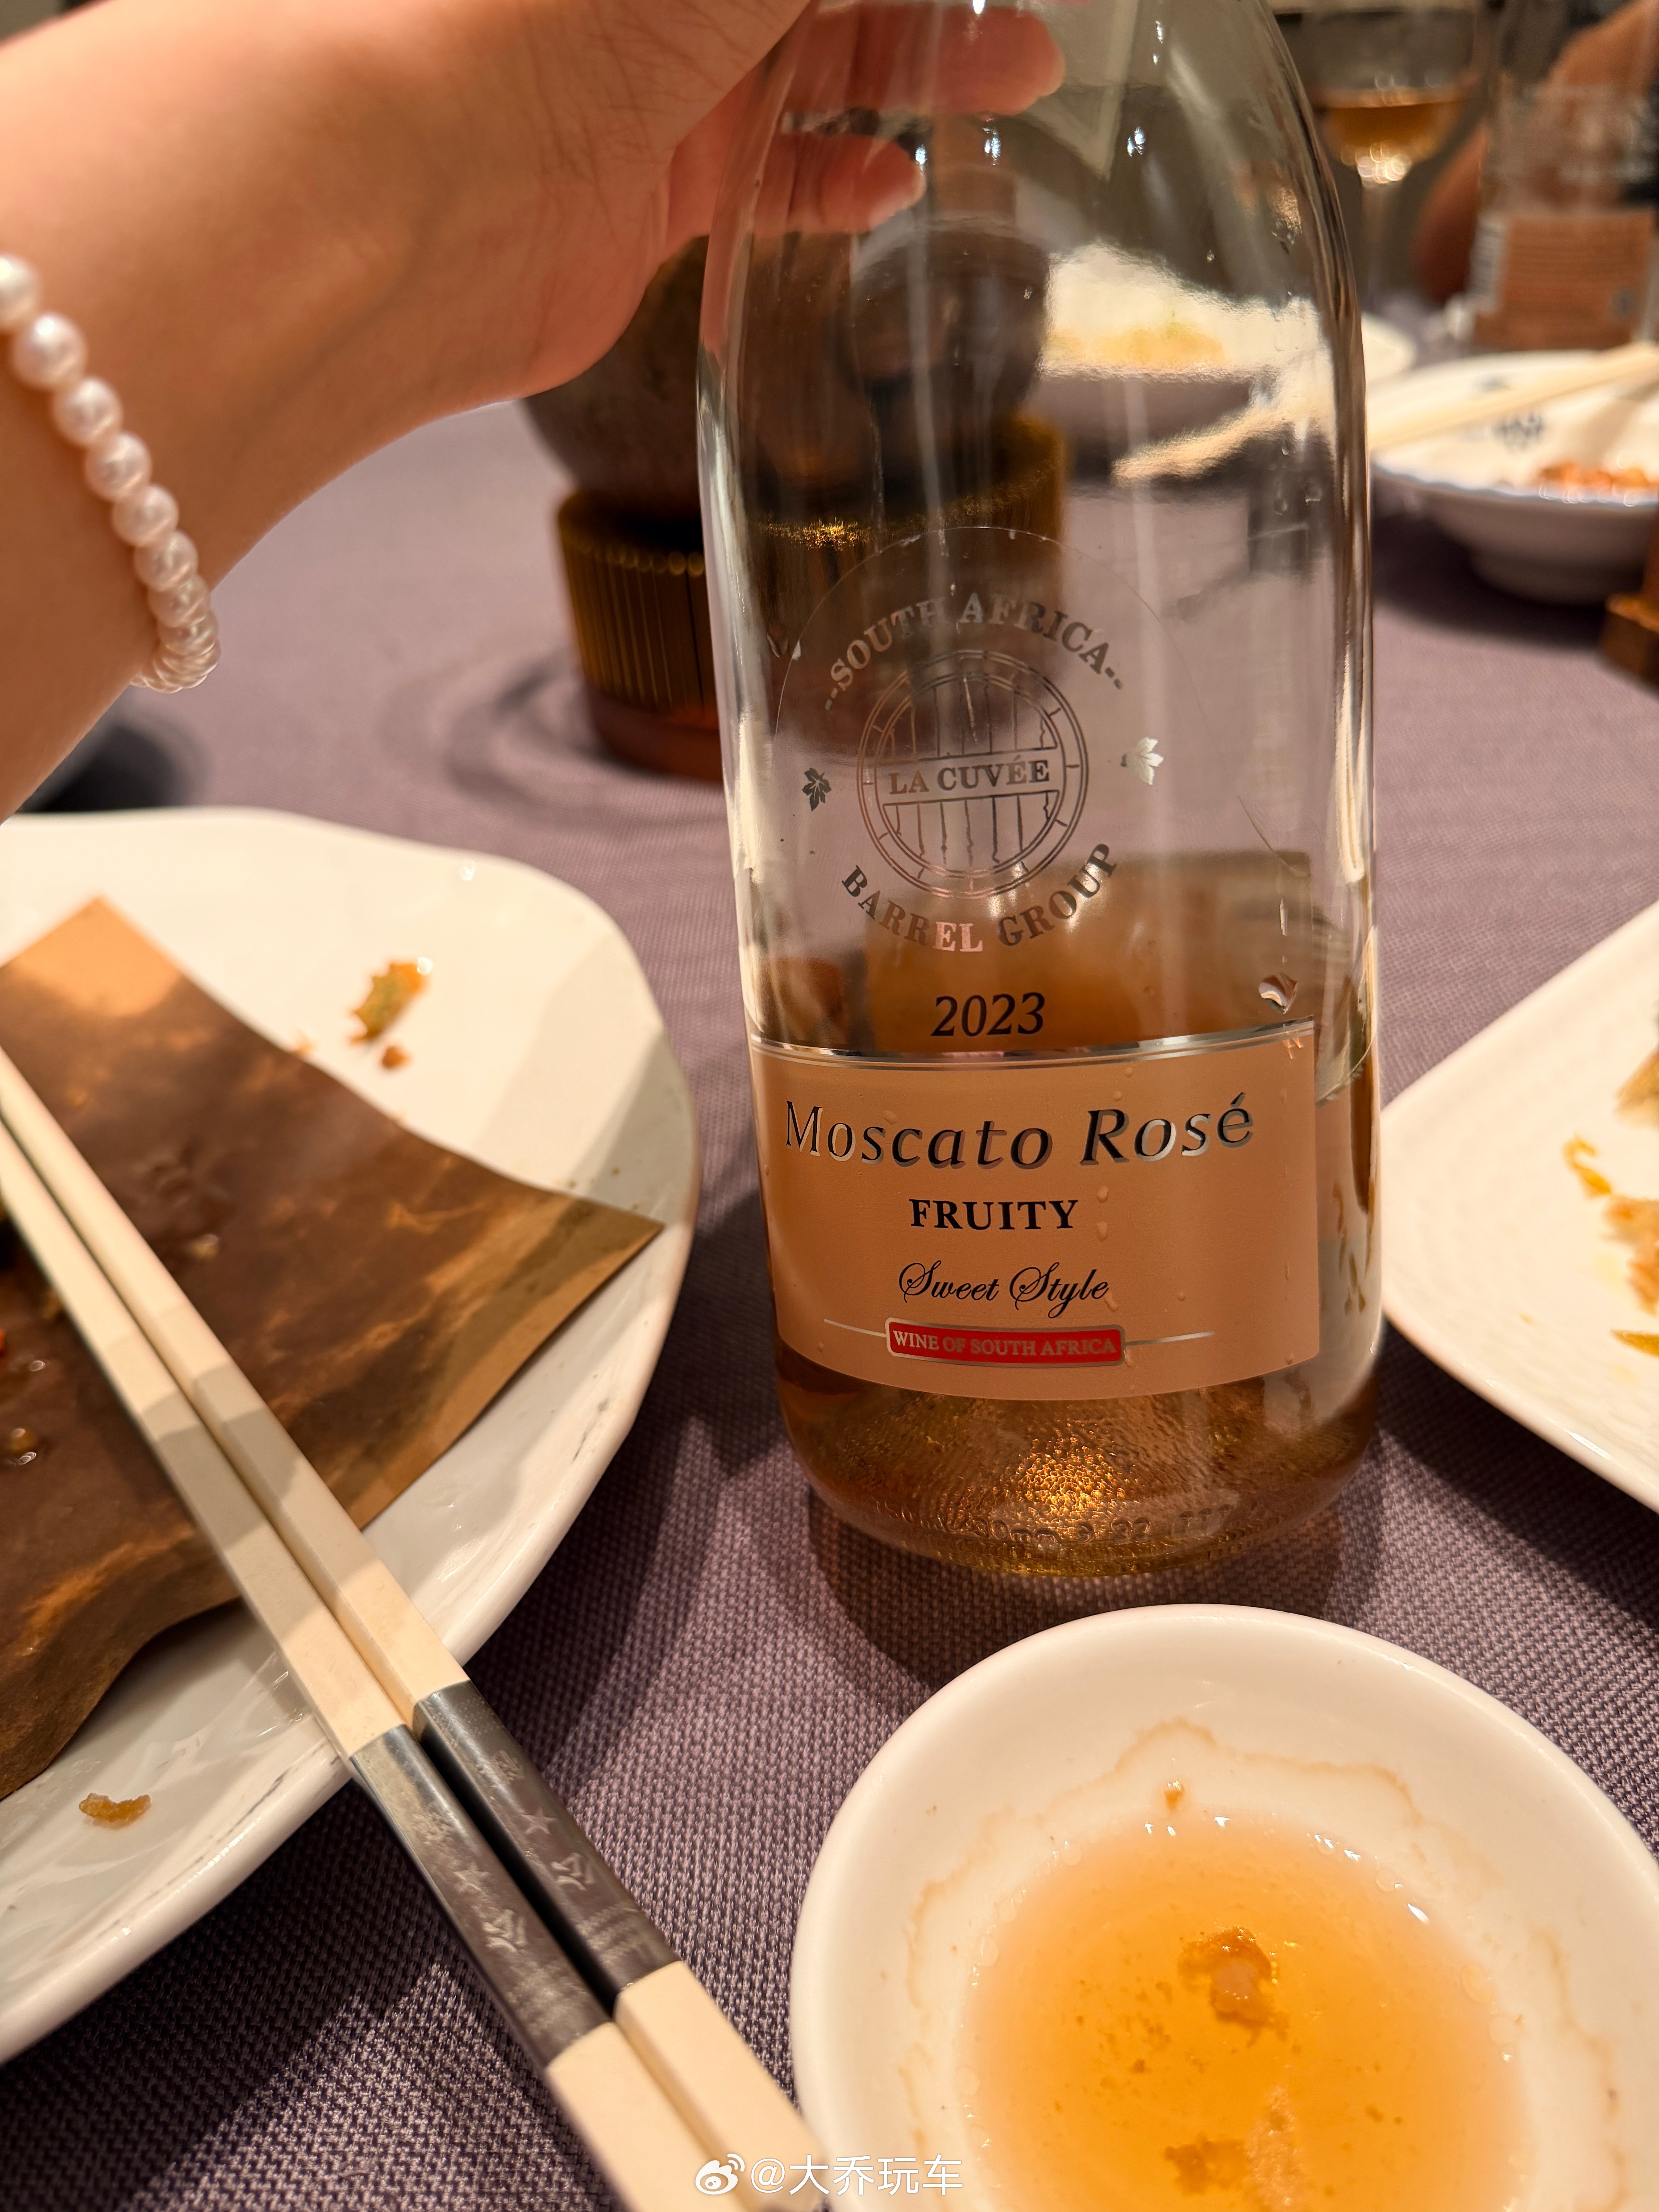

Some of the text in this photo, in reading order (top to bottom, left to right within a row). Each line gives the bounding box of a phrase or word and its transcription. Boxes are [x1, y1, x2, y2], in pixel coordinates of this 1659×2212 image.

[888, 754, 1050, 795] LA CUVÉE
[840, 843, 1117, 953] BARREL GROUP
[930, 992, 1046, 1037] 2023
[785, 1092, 1254, 1170] Moscato Rosé
[908, 1199, 1079, 1230] FRUITY
[898, 1260, 1109, 1319] Sweet Style
[892, 1329, 1118, 1356] WINE OF SOUTH AFRICA
